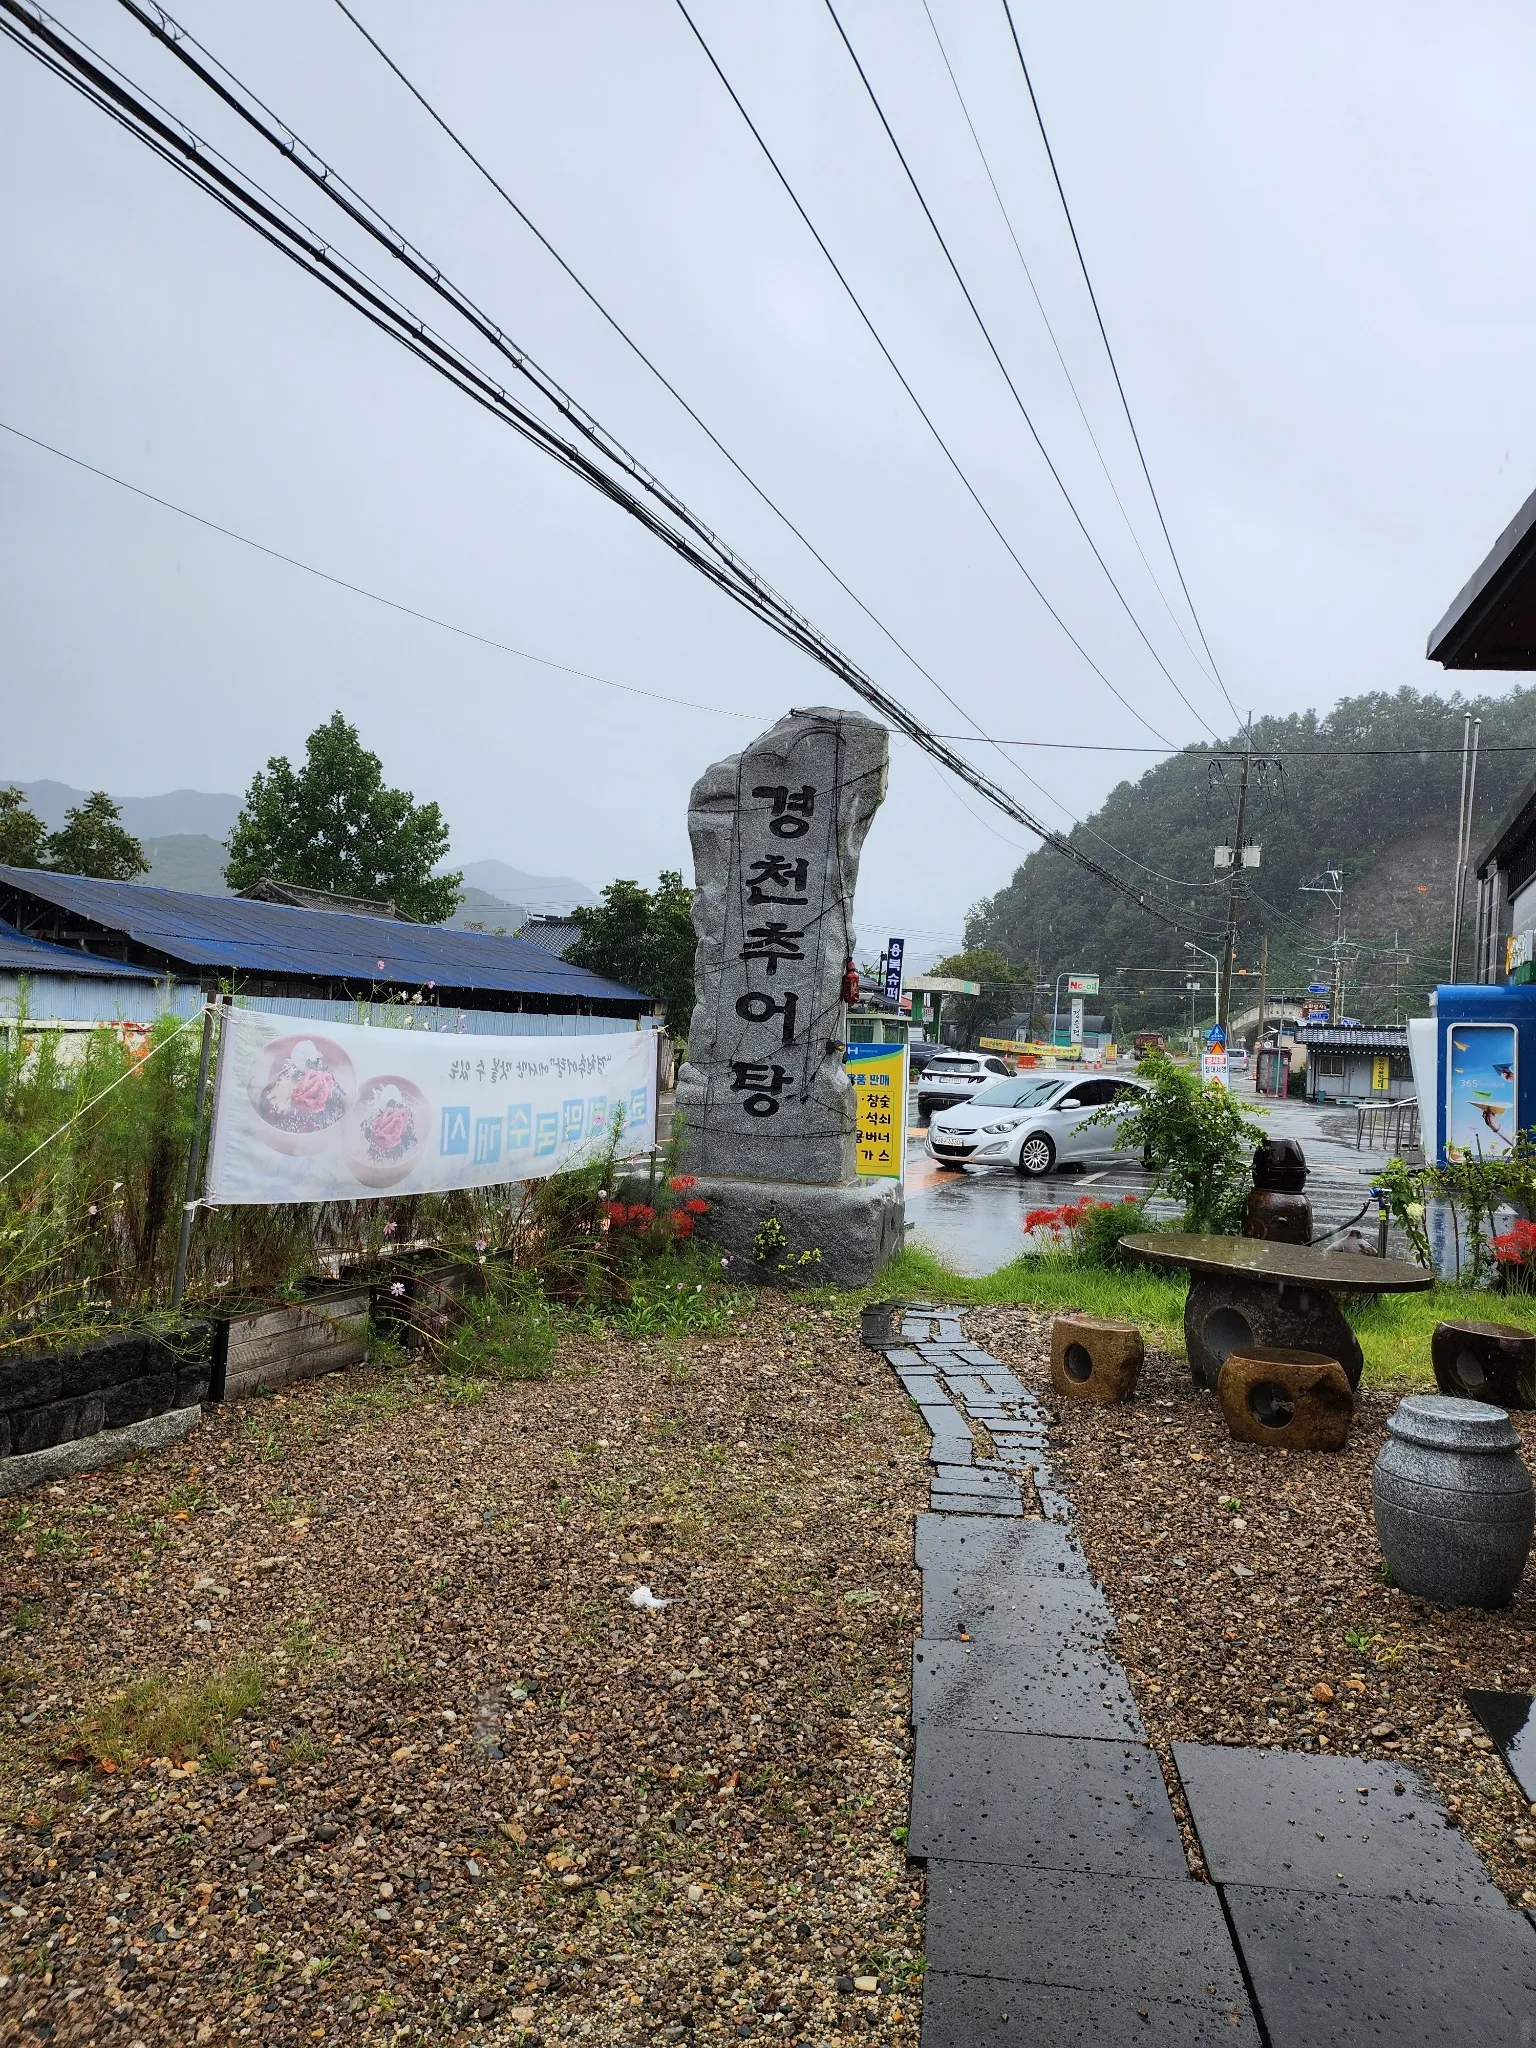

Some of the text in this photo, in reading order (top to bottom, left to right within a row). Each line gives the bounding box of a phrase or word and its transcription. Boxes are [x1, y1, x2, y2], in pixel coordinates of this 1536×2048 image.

[730, 785, 817, 1118] 경천추어탕
[886, 943, 902, 1001] 용복슈퍼
[869, 1074, 890, 1086] 판매
[1460, 1079, 1478, 1088] 365
